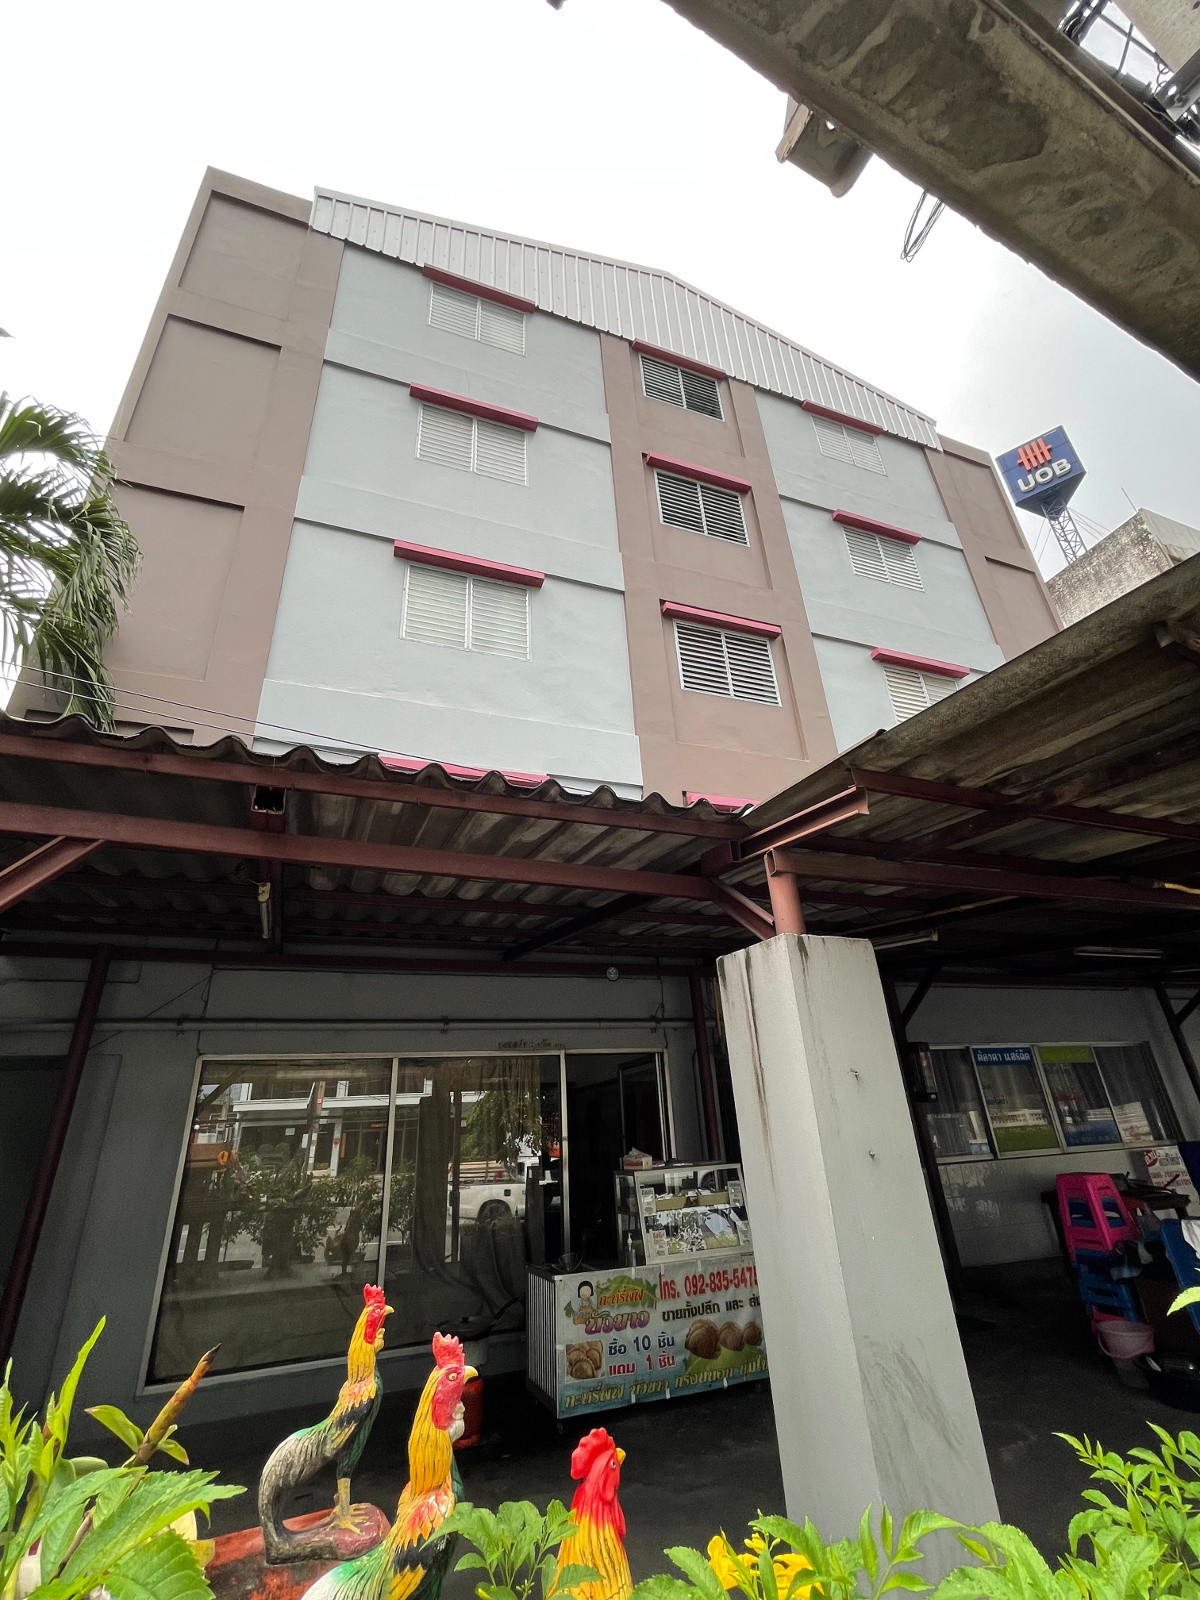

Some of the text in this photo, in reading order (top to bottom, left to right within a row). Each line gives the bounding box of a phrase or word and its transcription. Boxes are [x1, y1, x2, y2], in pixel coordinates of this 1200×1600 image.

[1017, 458, 1072, 493] UOB
[658, 1272, 680, 1300] โทร.
[662, 1300, 721, 1322] ขายทั้งปลีก
[725, 1299, 744, 1312] และ
[608, 1331, 676, 1356] ซื้อ 10 ชิ้น
[608, 1350, 676, 1376] แถม 1 ชิ้น
